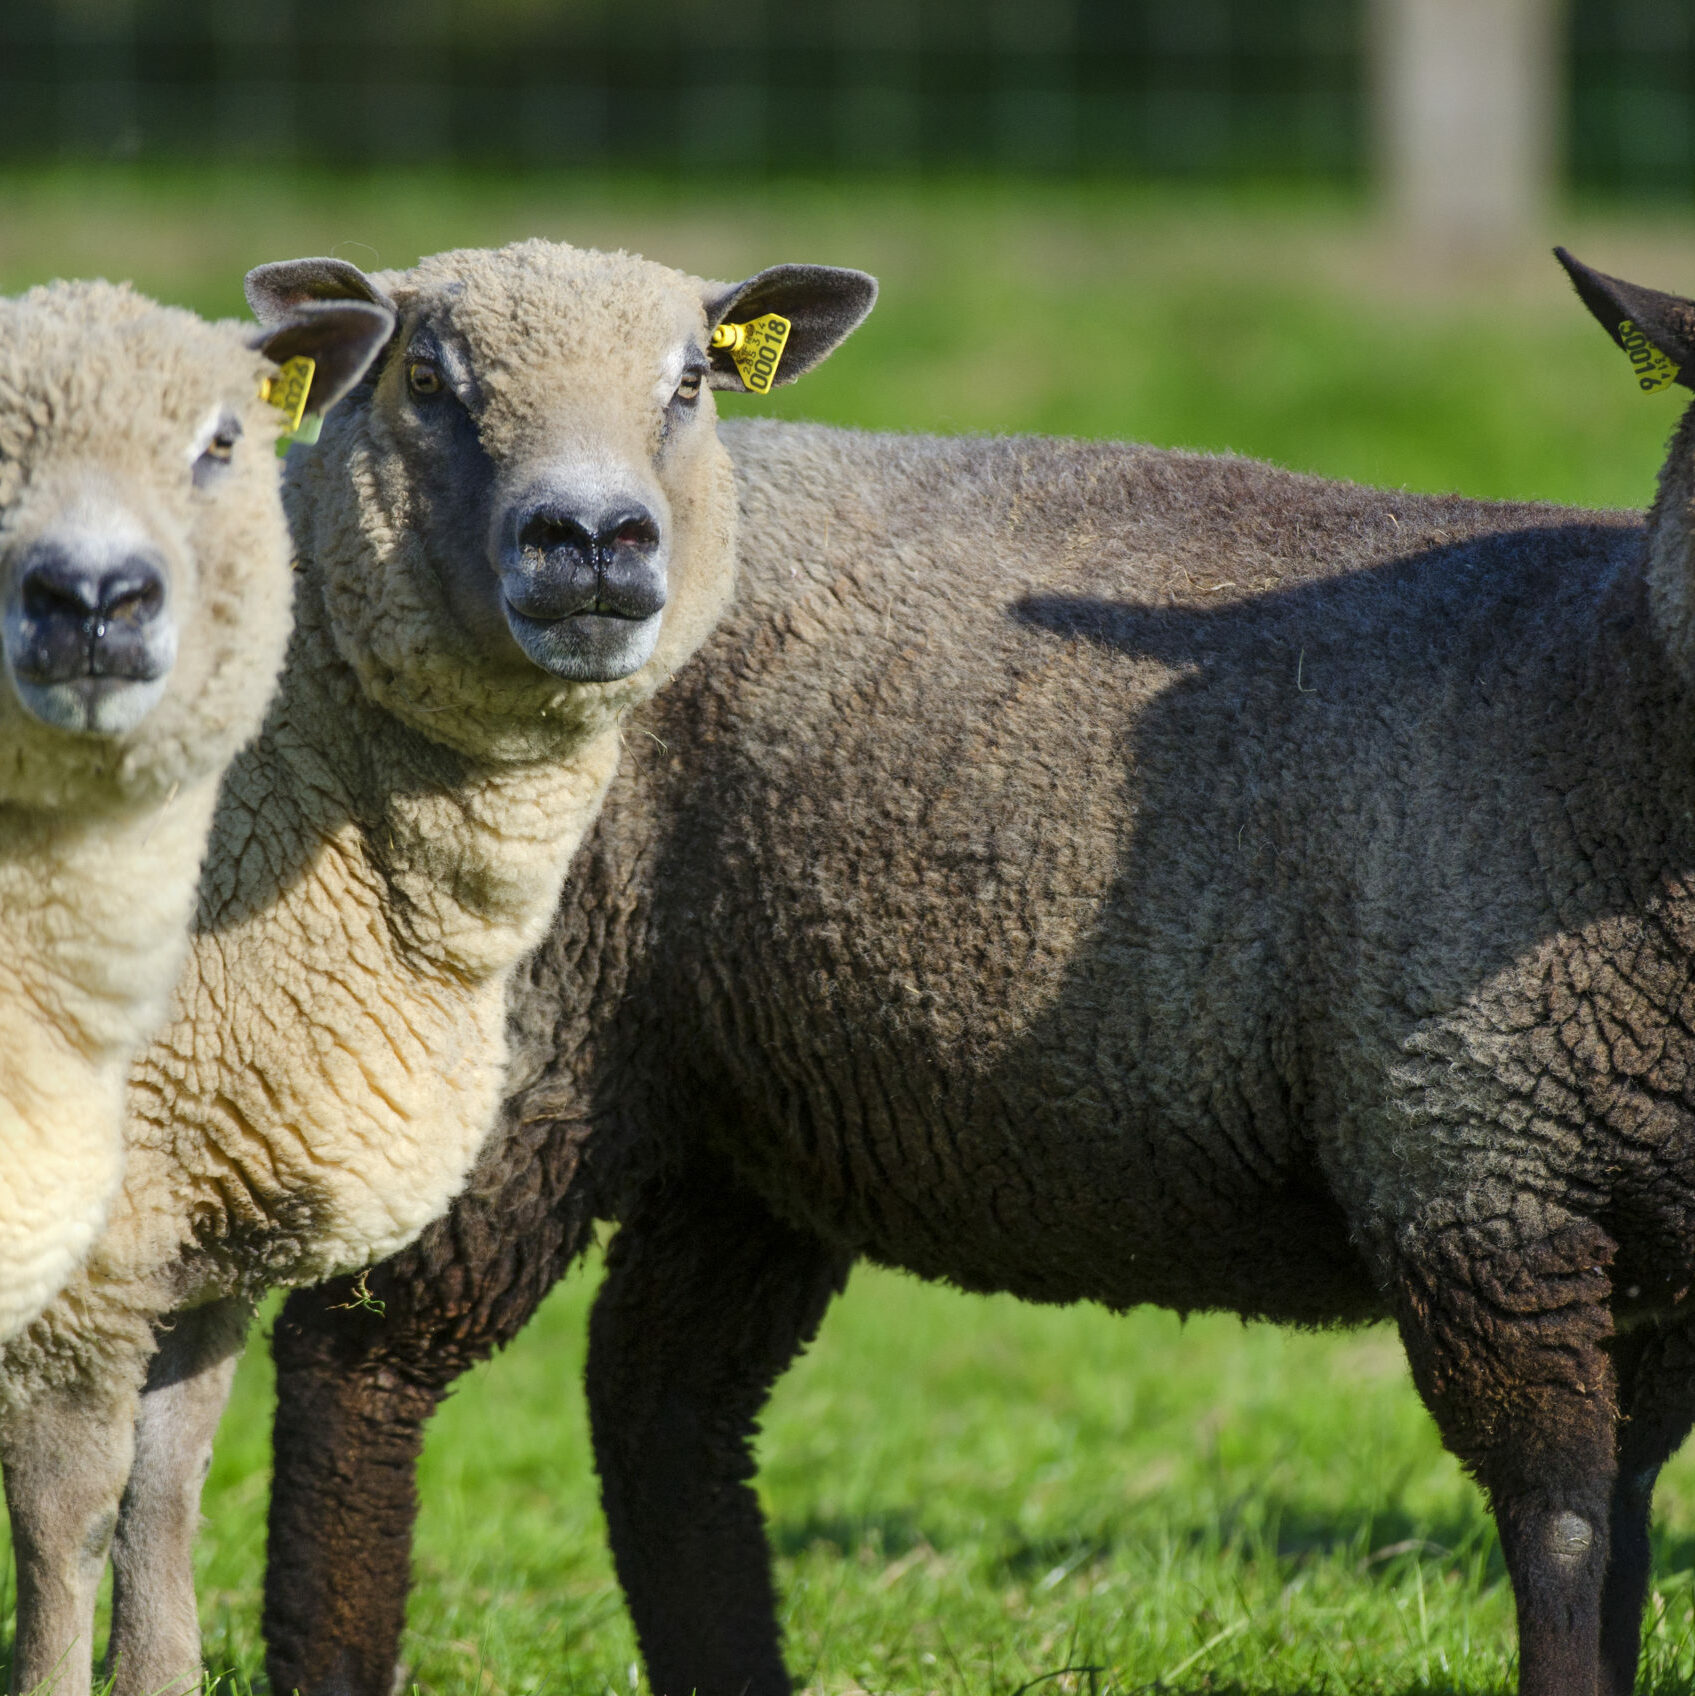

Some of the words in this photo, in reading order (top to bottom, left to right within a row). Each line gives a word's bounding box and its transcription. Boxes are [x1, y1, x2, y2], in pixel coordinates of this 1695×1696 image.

[742, 351, 757, 375] 285
[751, 322, 766, 346] 314
[750, 319, 786, 389] 00018
